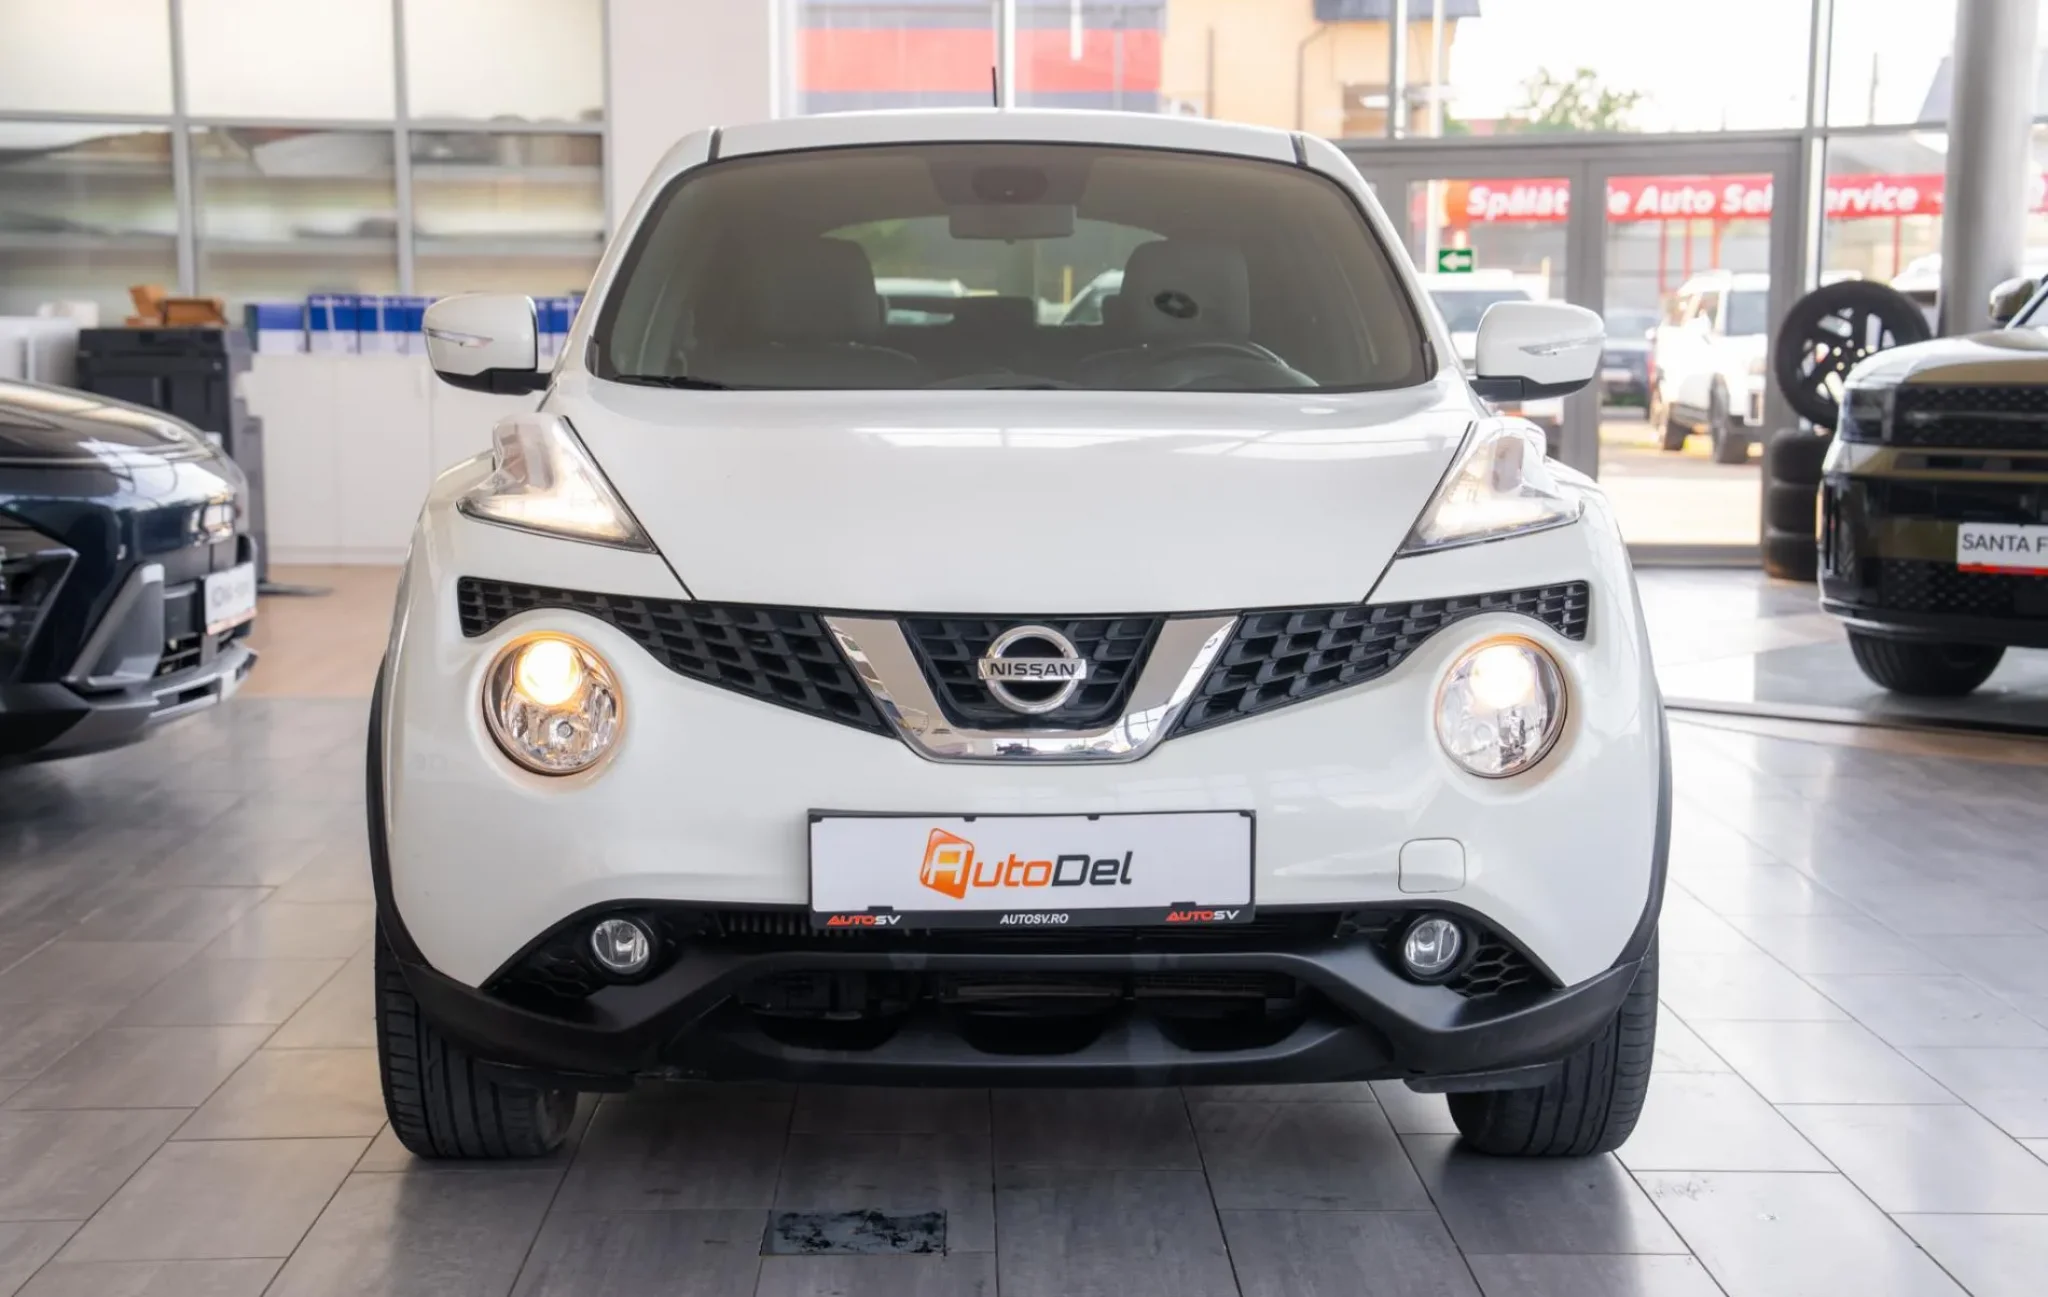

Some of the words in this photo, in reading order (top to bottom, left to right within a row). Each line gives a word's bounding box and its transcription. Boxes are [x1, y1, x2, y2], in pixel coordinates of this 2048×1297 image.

[1634, 185, 1716, 215] Auto
[1720, 183, 1773, 214] Sel
[1825, 181, 1918, 211] ervice
[1962, 533, 2031, 553] SANTA
[990, 662, 1076, 677] NISSAN
[921, 835, 1133, 890] AutoDel
[826, 915, 901, 926] AUTOSV
[1000, 913, 1069, 925] AUTOSV.RO
[1165, 909, 1240, 922] AUTOSV
